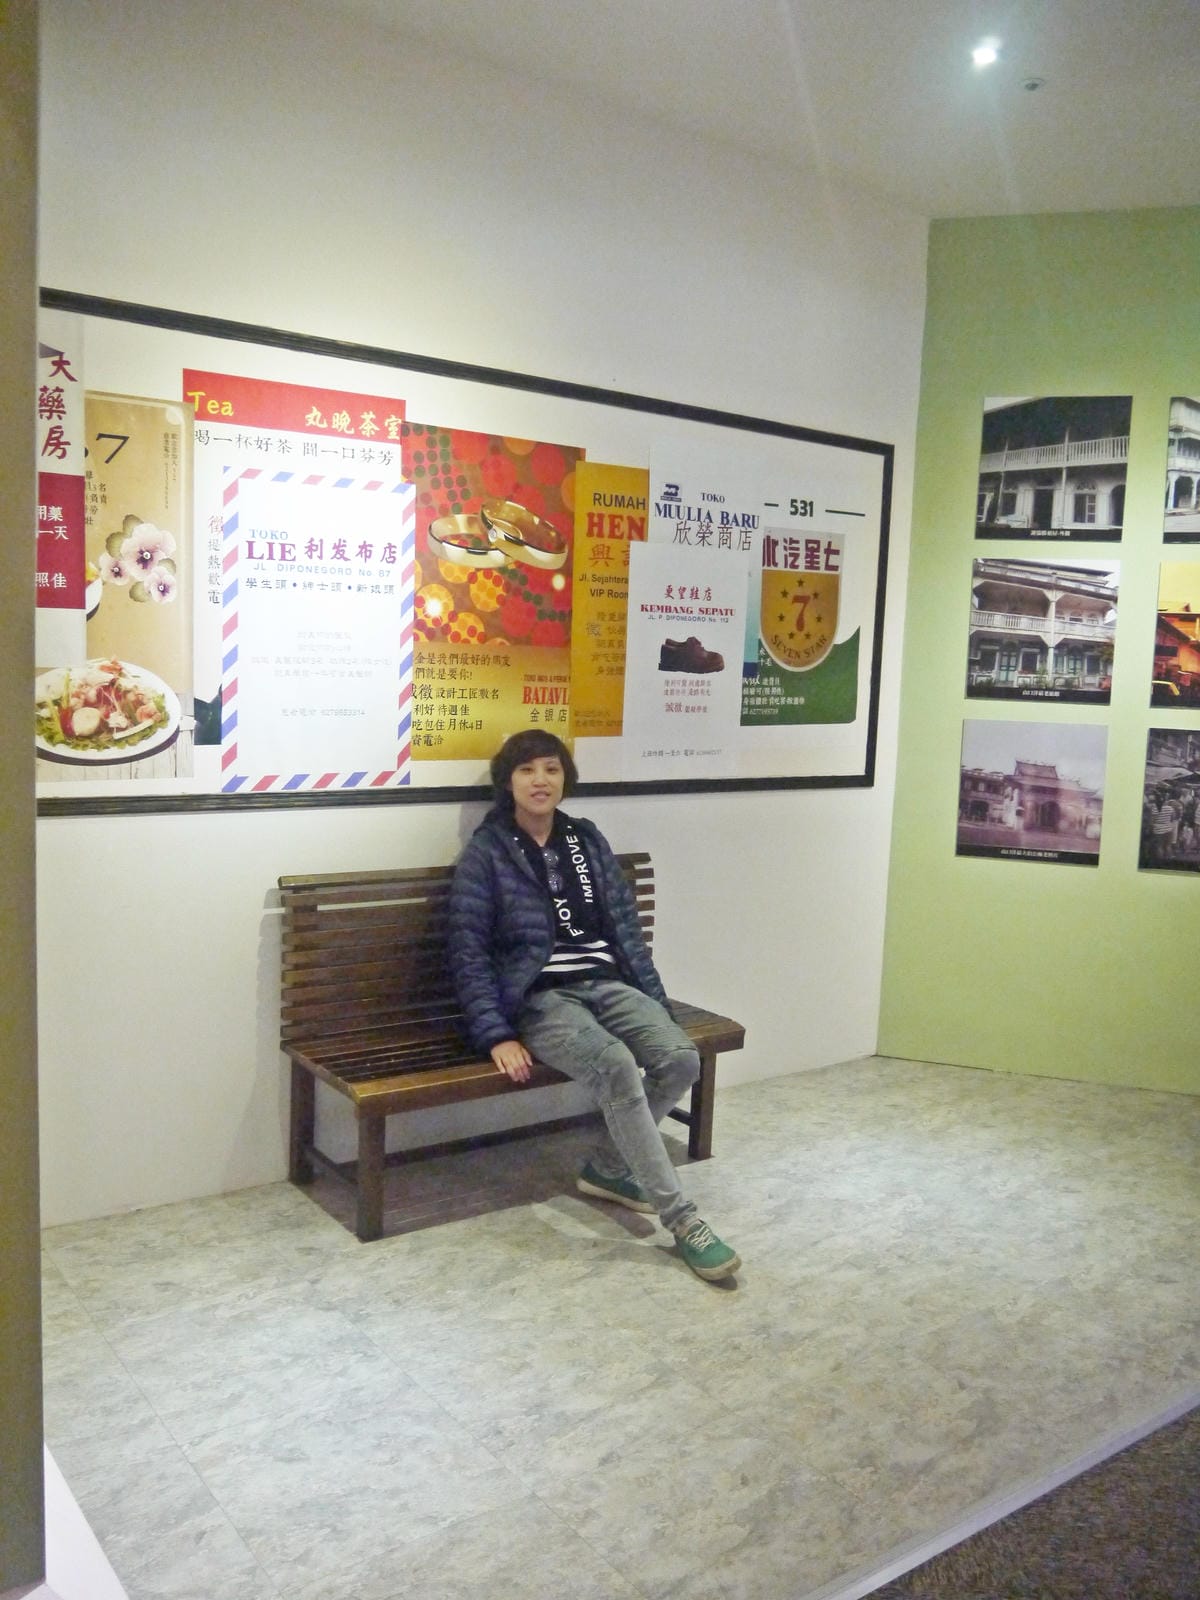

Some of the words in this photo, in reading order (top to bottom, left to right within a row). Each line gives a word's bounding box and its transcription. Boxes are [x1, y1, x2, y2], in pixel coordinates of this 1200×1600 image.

[186, 391, 235, 417] Tea
[593, 492, 647, 511] RUMAH
[701, 492, 726, 504] TOKO
[789, 498, 814, 517] 531
[720, 511, 760, 530] BARU
[248, 528, 289, 541] TOKO
[672, 520, 753, 552] 欣榮商店
[245, 540, 297, 562] LIE
[303, 537, 398, 565] 利发布店
[253, 562, 267, 571] JL
[277, 563, 352, 576] DIPONEGORO
[379, 569, 392, 578] 87
[589, 588, 604, 598] VIP
[640, 604, 694, 615] KEMBANG
[698, 607, 737, 617] SEPATU
[791, 594, 811, 632] 7
[770, 633, 801, 660] SEVEN
[566, 834, 594, 903] IMPROVE
